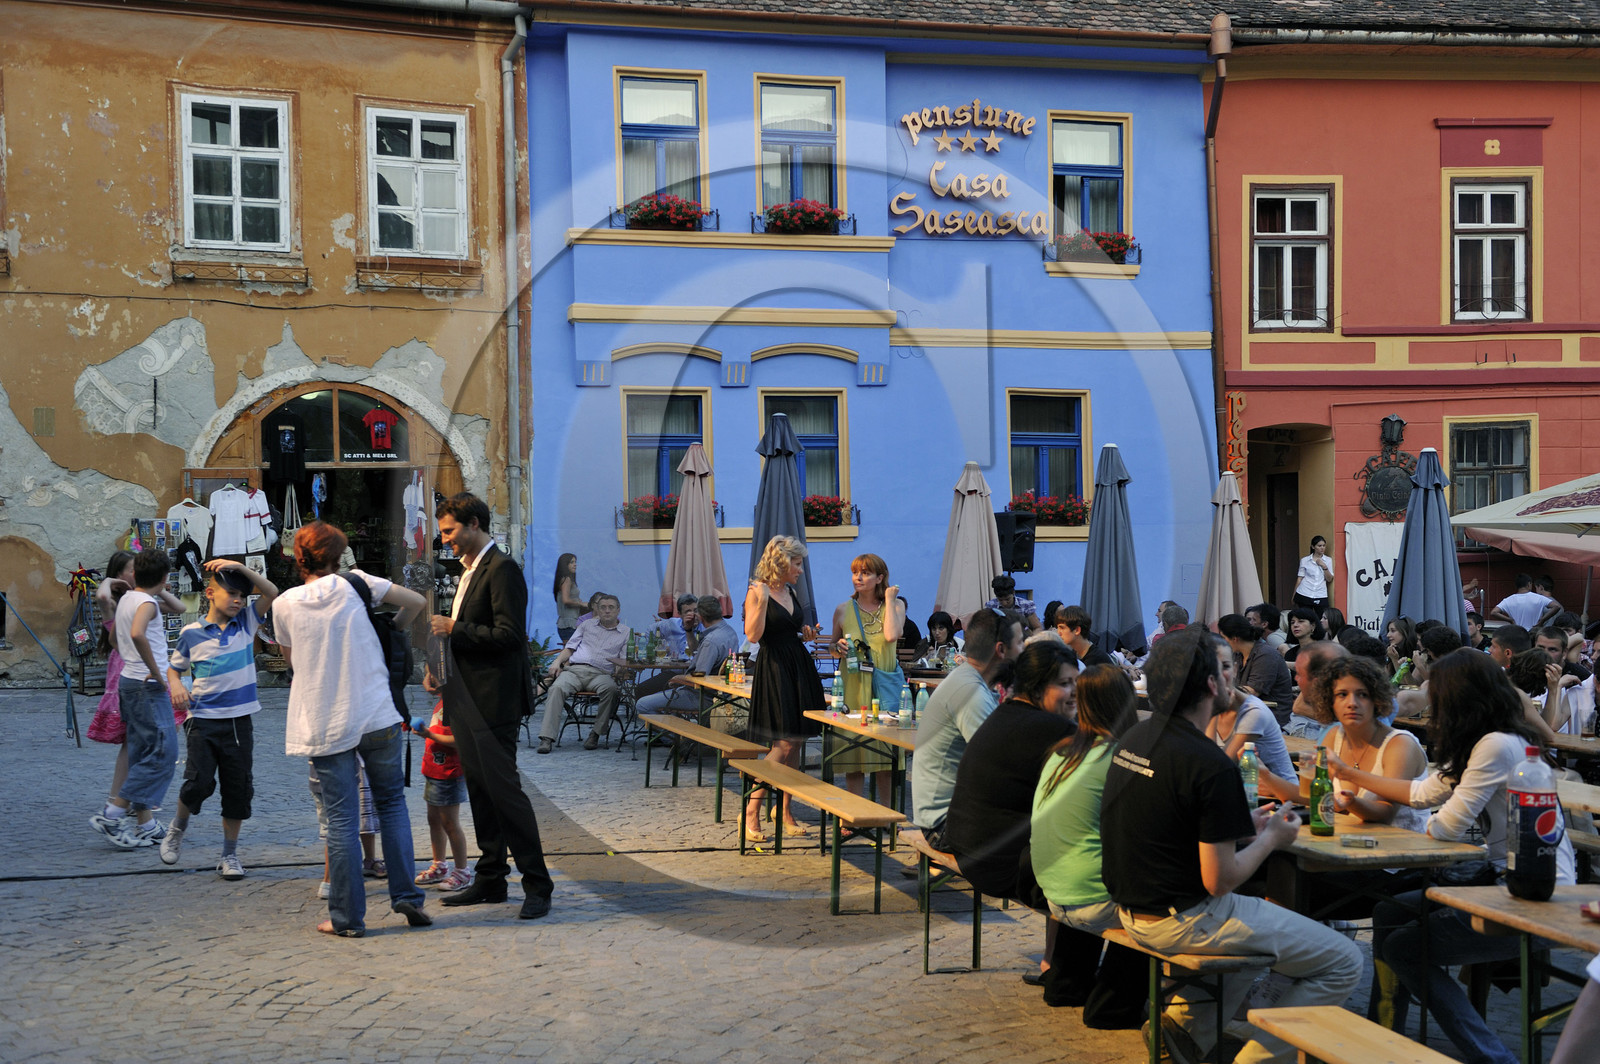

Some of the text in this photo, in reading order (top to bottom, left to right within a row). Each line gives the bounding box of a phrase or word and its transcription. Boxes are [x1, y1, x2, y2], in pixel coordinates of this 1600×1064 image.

[901, 98, 1037, 146] pensiune
[929, 161, 1011, 198] Casa
[890, 191, 1050, 235] Saseasca
